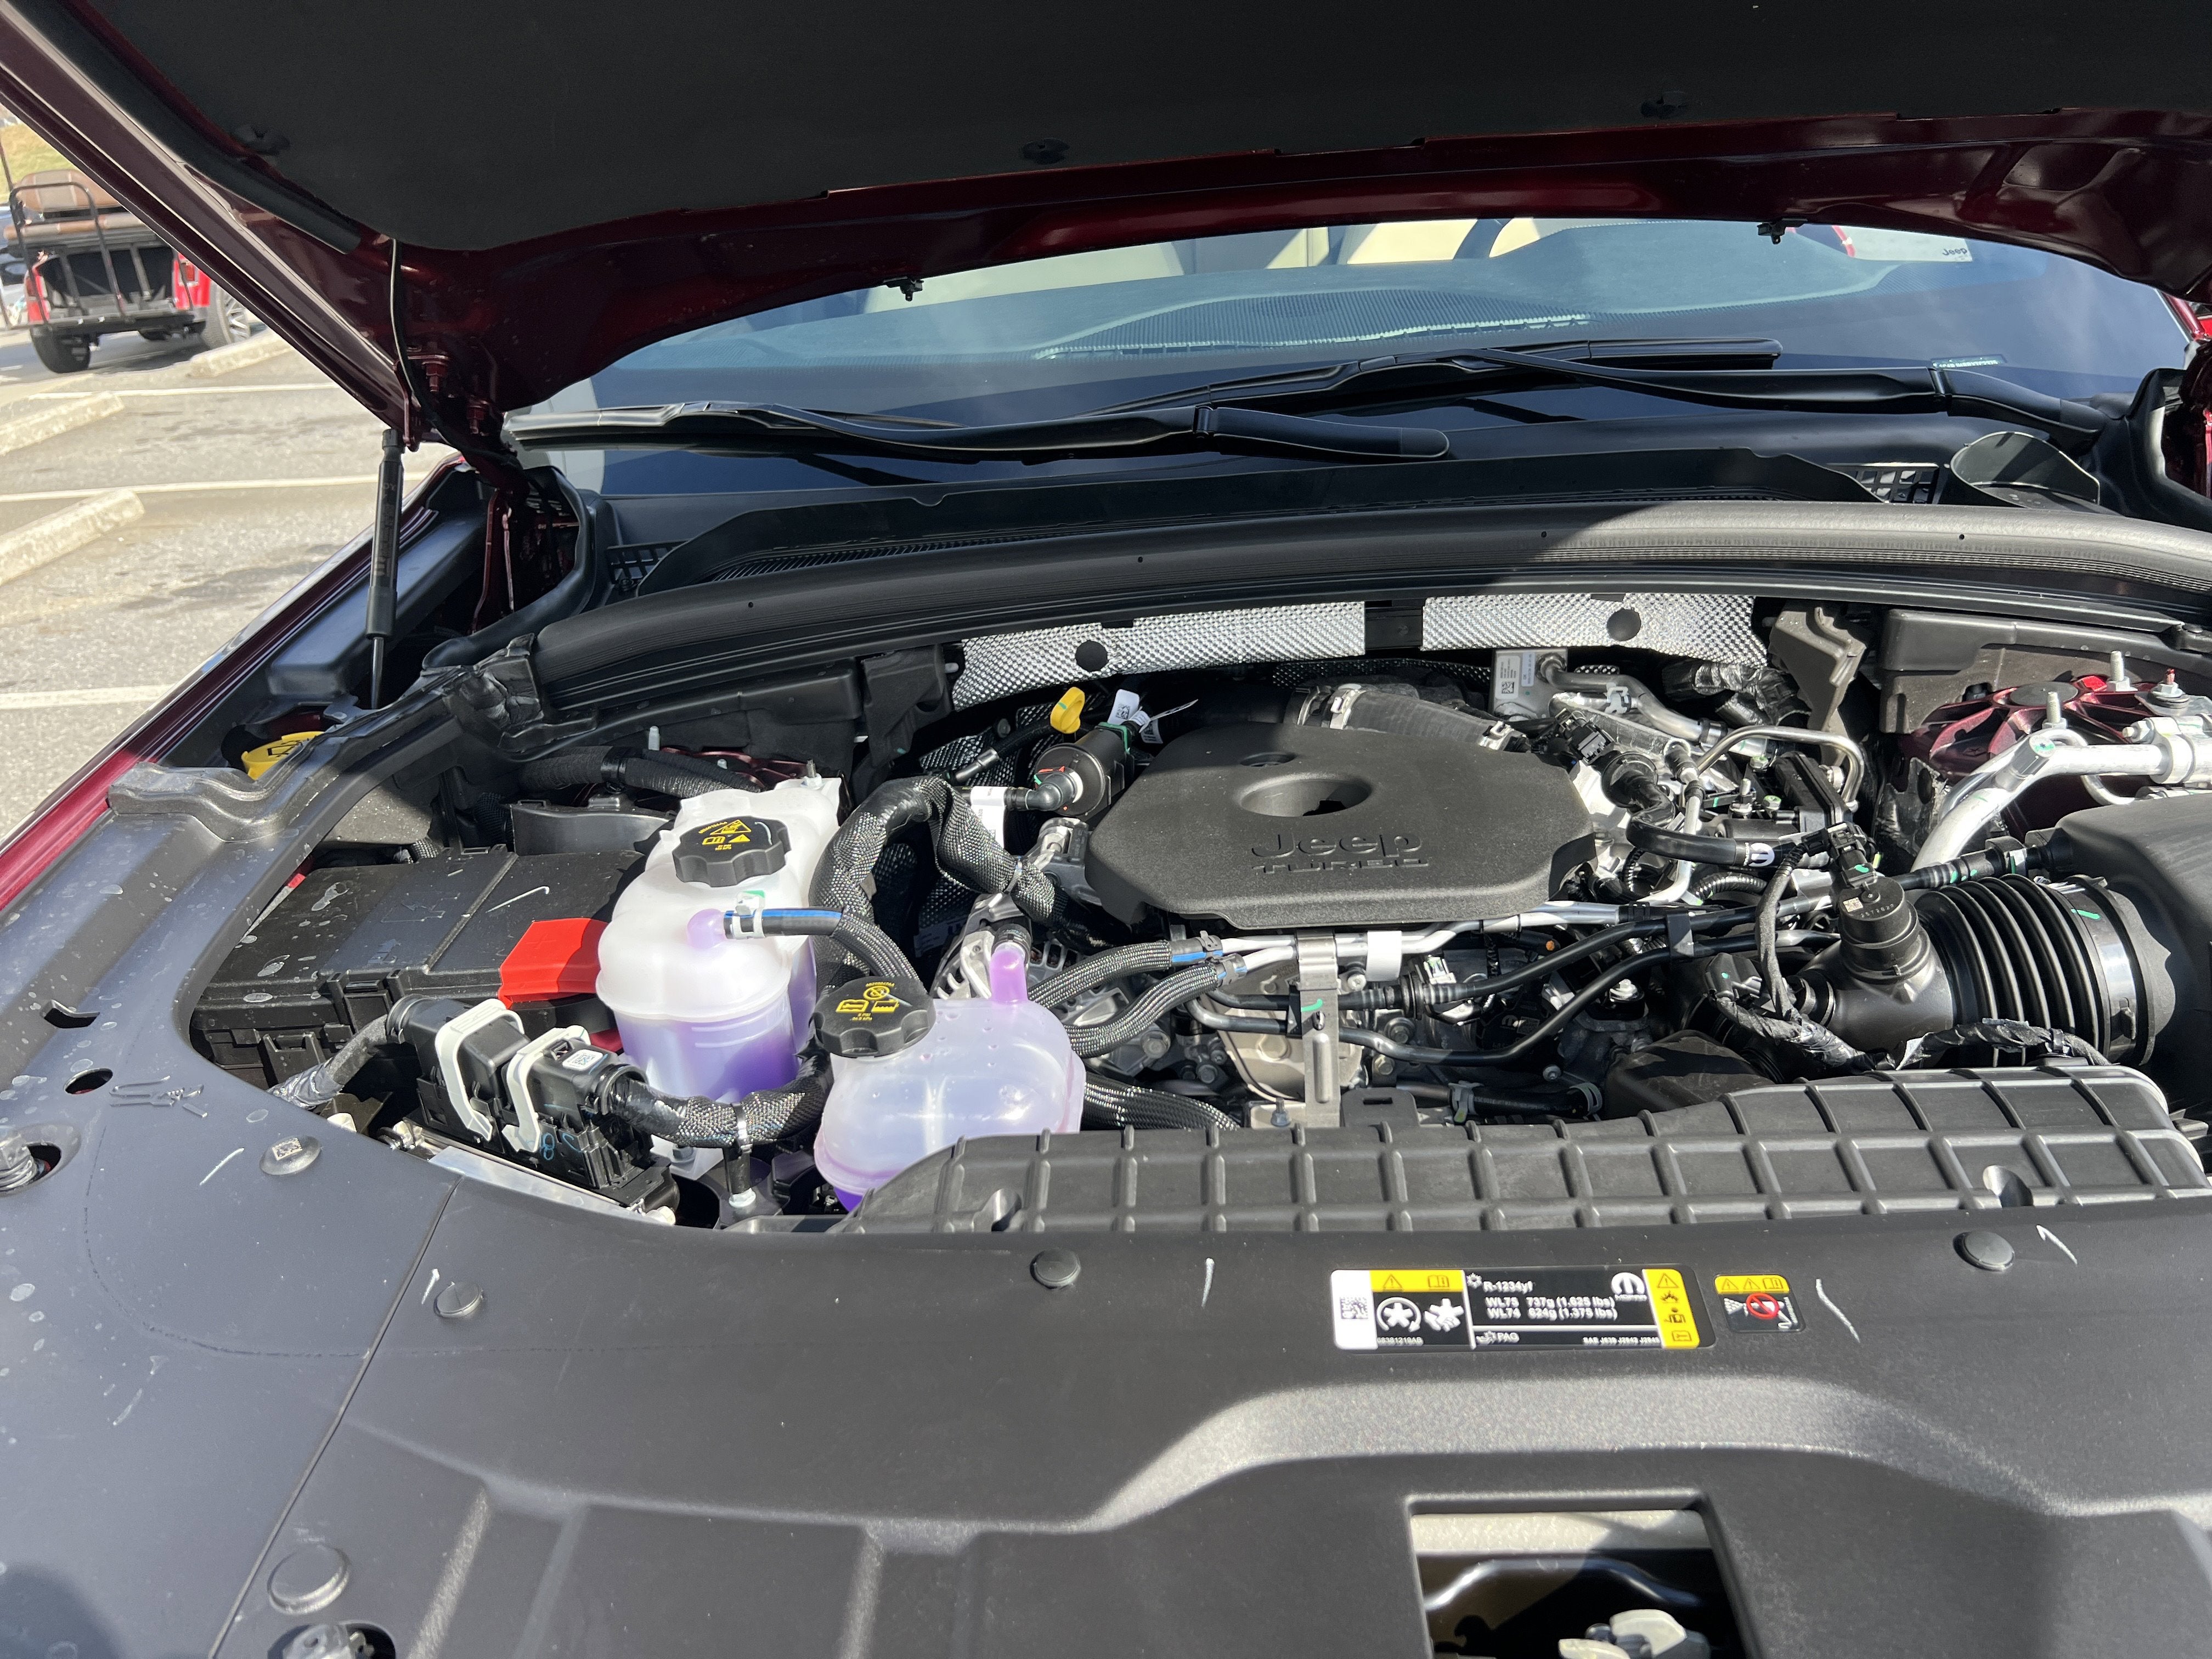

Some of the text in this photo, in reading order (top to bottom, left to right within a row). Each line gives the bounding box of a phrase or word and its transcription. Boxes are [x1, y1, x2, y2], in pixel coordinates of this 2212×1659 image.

[1251, 832, 1423, 859] Jeep
[1483, 1280, 1533, 1294] R-1234yf
[1485, 1296, 1520, 1308] WL75
[1526, 1296, 1556, 1310] 737g
[1592, 1296, 1616, 1308] lbs)
[1487, 1307, 1521, 1319] WL74
[1527, 1307, 1558, 1321] 624g
[1594, 1307, 1618, 1321] lbs)
[1497, 1332, 1520, 1343] PAG
